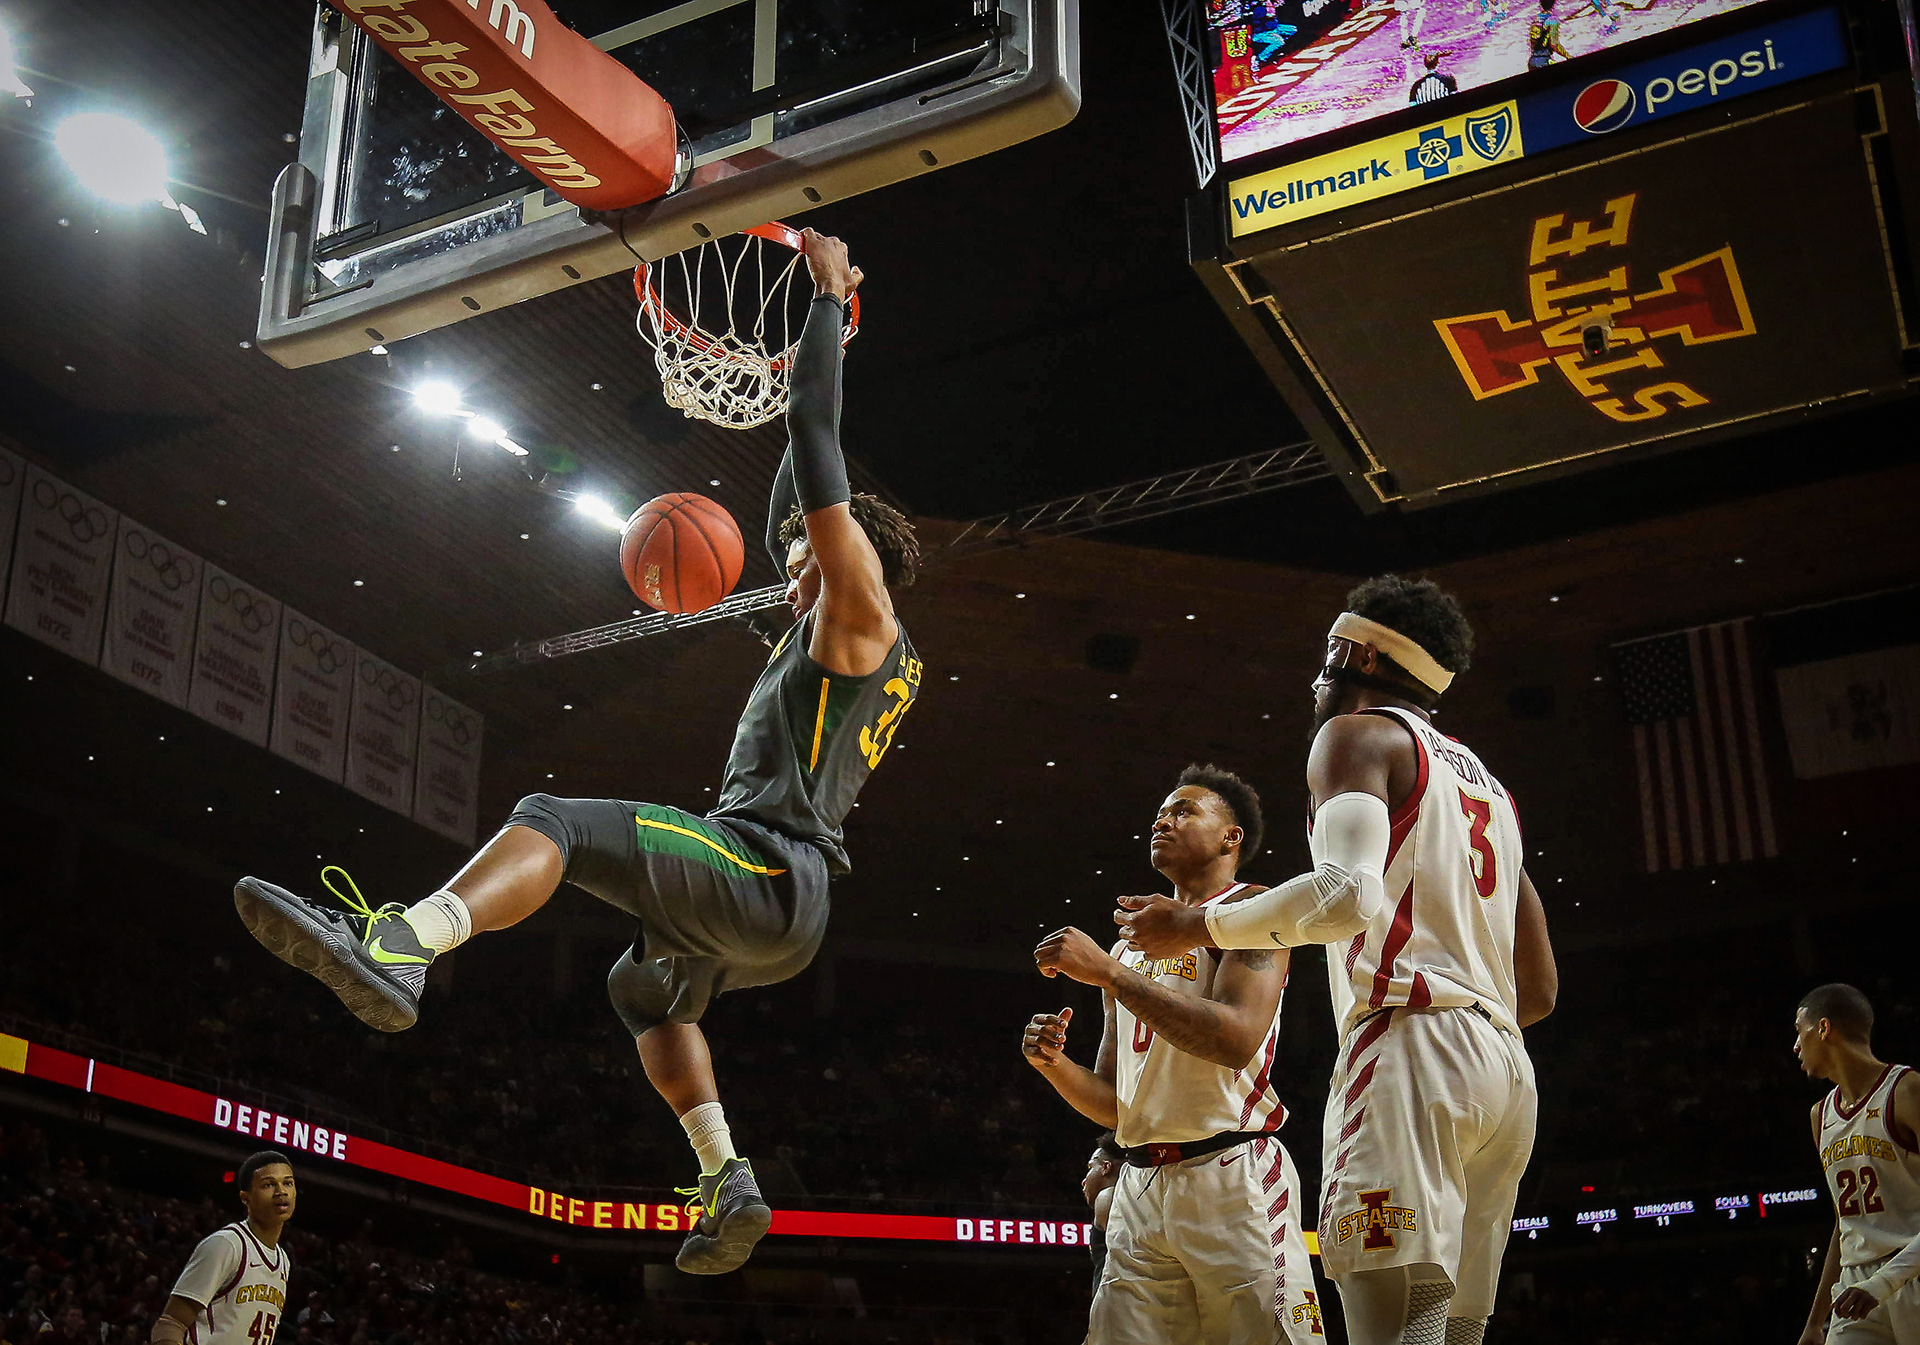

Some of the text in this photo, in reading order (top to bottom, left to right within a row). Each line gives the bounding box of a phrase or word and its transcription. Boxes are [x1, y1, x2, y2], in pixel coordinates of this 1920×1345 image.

[1645, 38, 1778, 114] pepsi
[344, 0, 602, 190] tateFarm
[1232, 158, 1393, 219] Wellmark
[36, 611, 72, 642] 1972
[130, 657, 163, 688] 1972
[1457, 784, 1498, 901] 3
[214, 1097, 348, 1160] DEFENSE
[1715, 1194, 1750, 1207] FOULS
[1761, 1188, 1818, 1205] CYCLONES
[1836, 1166, 1885, 1217] 22
[1512, 1216, 1549, 1229] STEALS
[1576, 1208, 1617, 1222] ASSISTS
[1634, 1201, 1694, 1216] TURNOVERS
[1656, 1215, 1670, 1227] 11
[1337, 1206, 1418, 1246] STATE
[1528, 1229, 1538, 1240] 4
[1592, 1222, 1602, 1233] 4
[247, 1310, 277, 1345] 45
